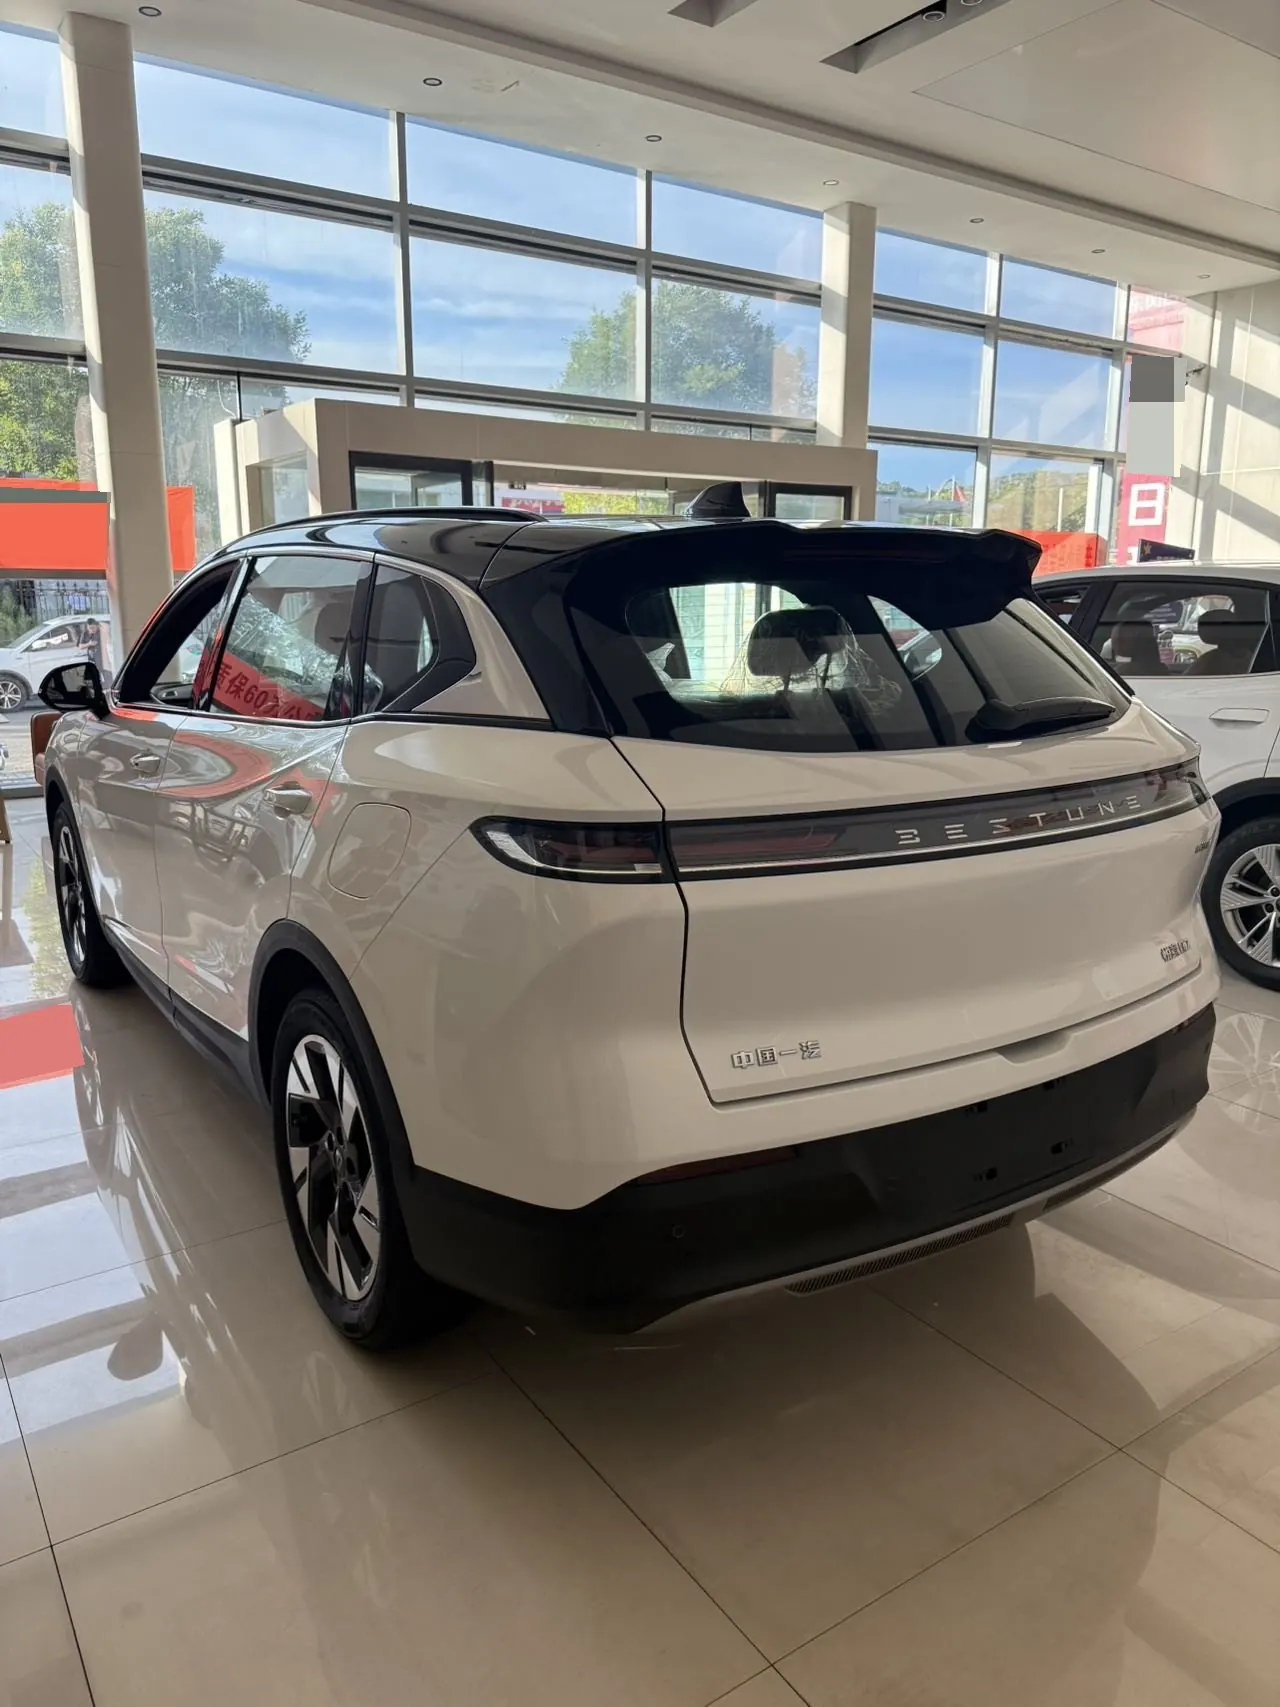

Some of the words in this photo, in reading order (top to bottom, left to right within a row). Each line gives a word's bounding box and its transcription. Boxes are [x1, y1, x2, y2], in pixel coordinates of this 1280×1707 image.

[895, 796, 1141, 845] BESTUNE
[731, 1039, 821, 1069] 中国一汽
